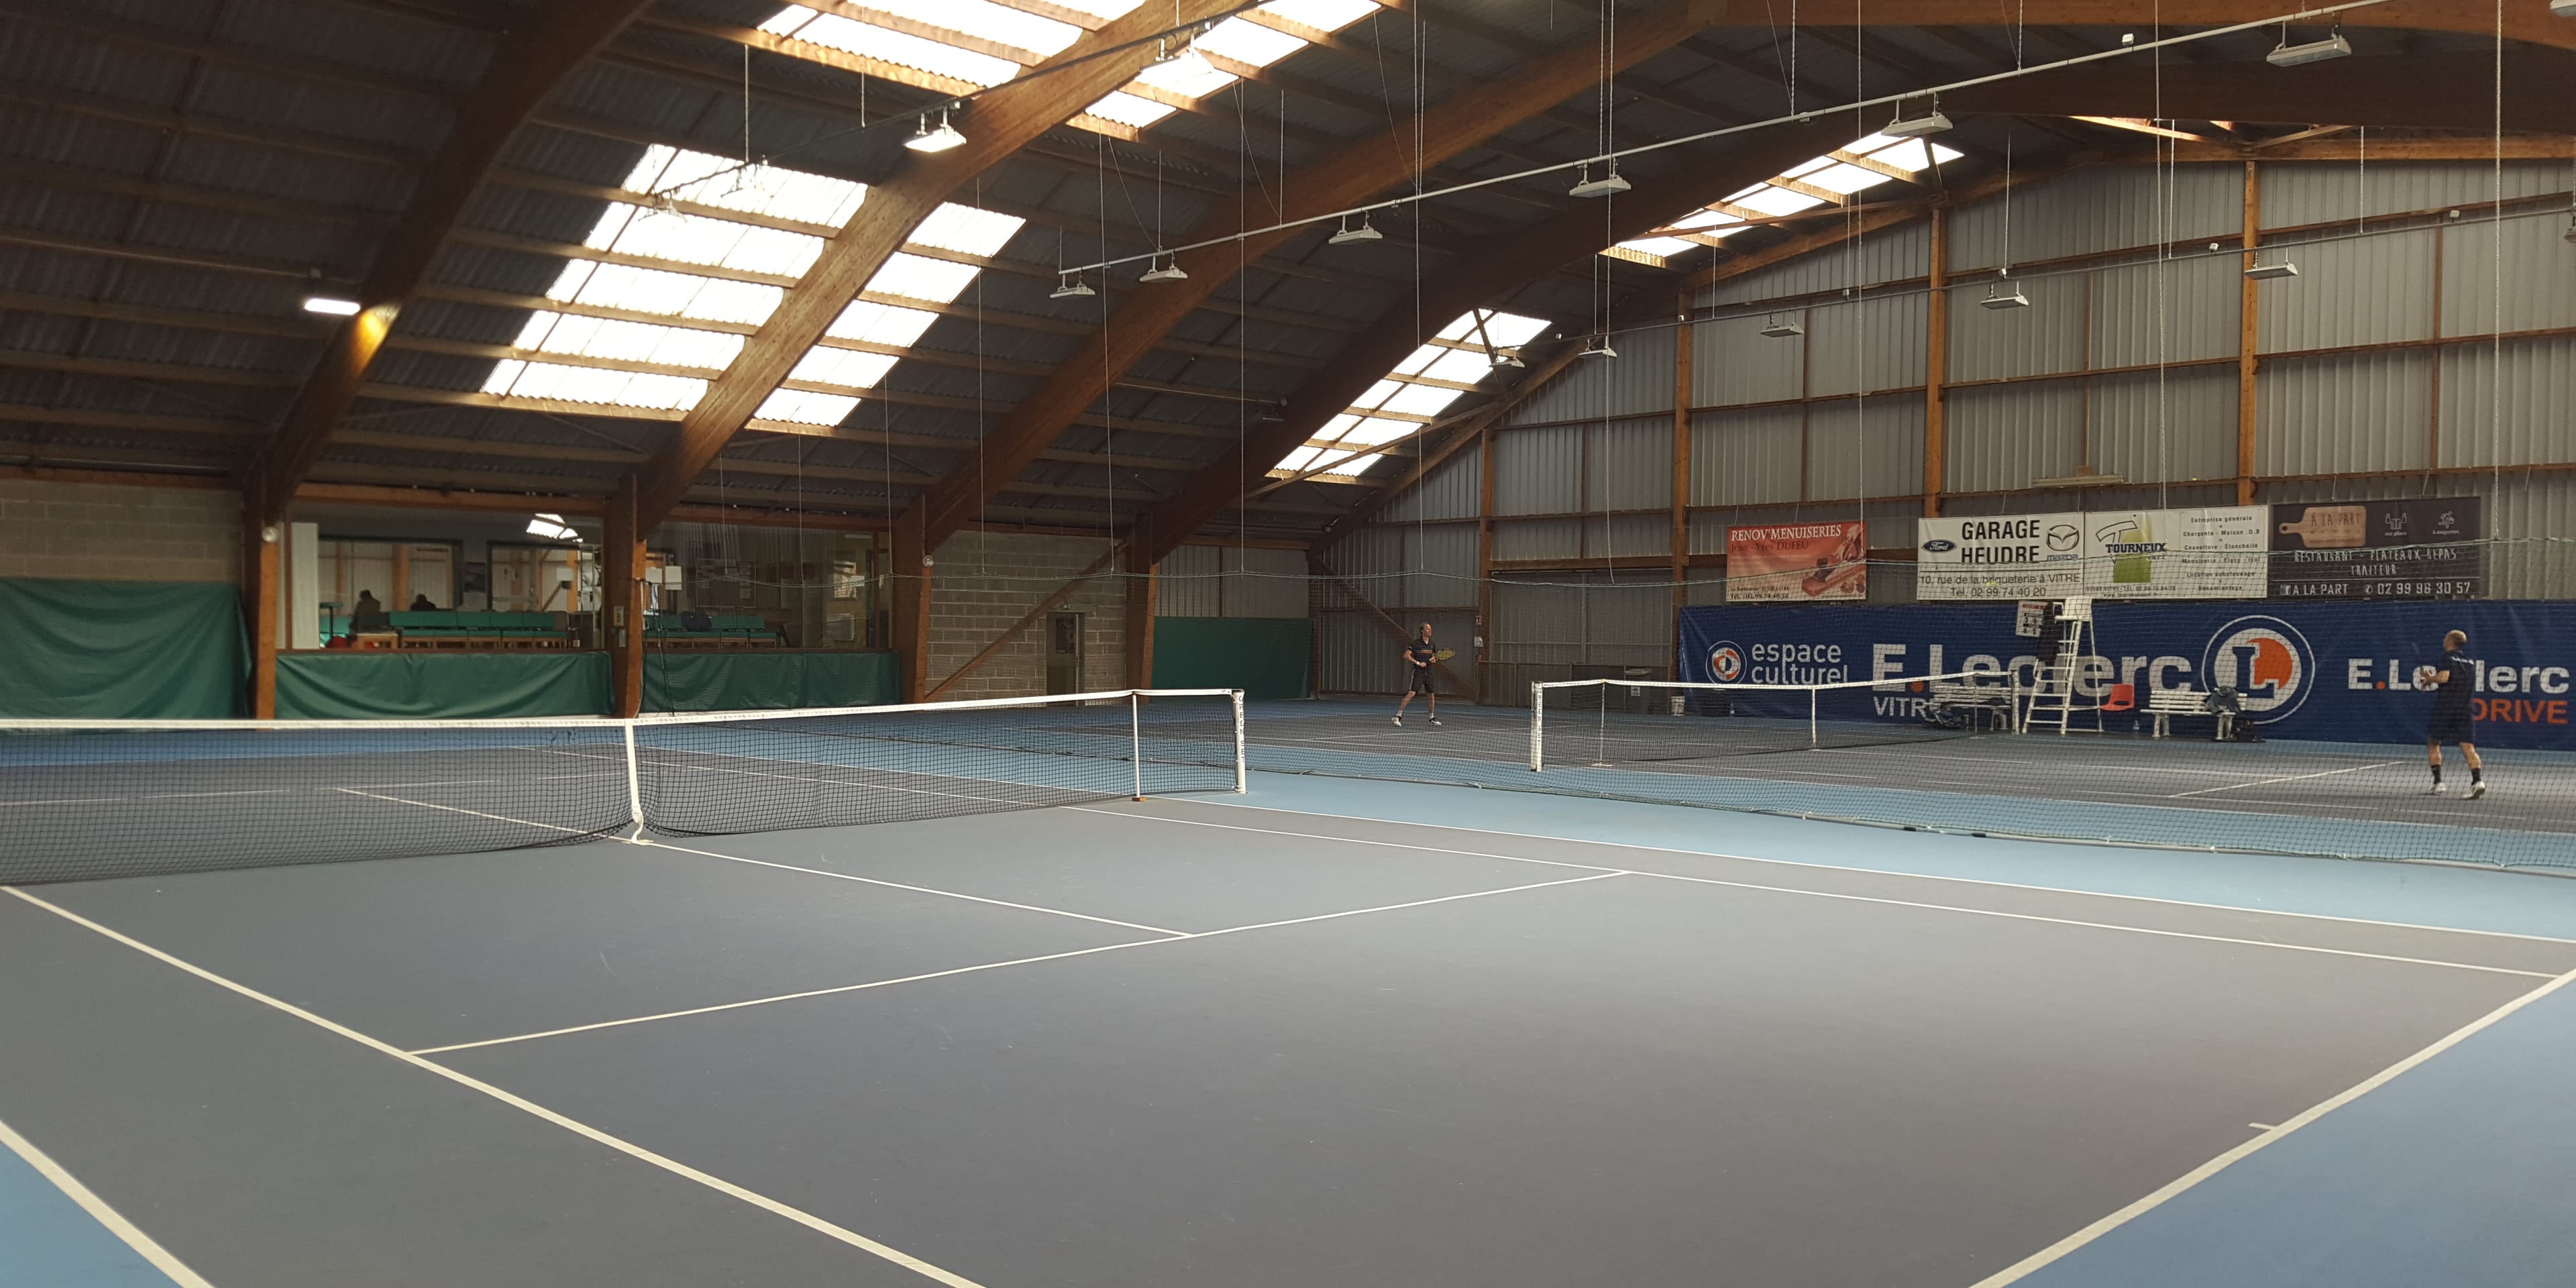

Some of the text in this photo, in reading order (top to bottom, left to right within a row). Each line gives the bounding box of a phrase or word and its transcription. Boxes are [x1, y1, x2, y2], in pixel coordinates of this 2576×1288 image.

[2322, 513, 2332, 526] LA
[2339, 512, 2359, 526] PART
[1731, 524, 1841, 541] RENOV'MENUISERIES
[1962, 520, 2040, 540] GARAGE
[1962, 545, 2040, 564] HEUDRE
[2105, 542, 2167, 553] TOURNEUX
[2351, 564, 2397, 576] TRAITEUR
[1955, 576, 1968, 584] de
[1971, 576, 1979, 584] la
[1971, 588, 1983, 596] 02
[1986, 588, 1998, 596] 99
[2002, 587, 2013, 596] 74
[2017, 587, 2030, 596] 40
[2033, 586, 2046, 596] 20
[2304, 584, 2315, 594] LA
[2320, 584, 2348, 594] PART
[2377, 584, 2392, 594] 02
[2396, 583, 2411, 594] 99
[1752, 643, 1842, 667] espace
[1752, 665, 1848, 685] culturel
[2348, 658, 2571, 694] E.Lelerc
